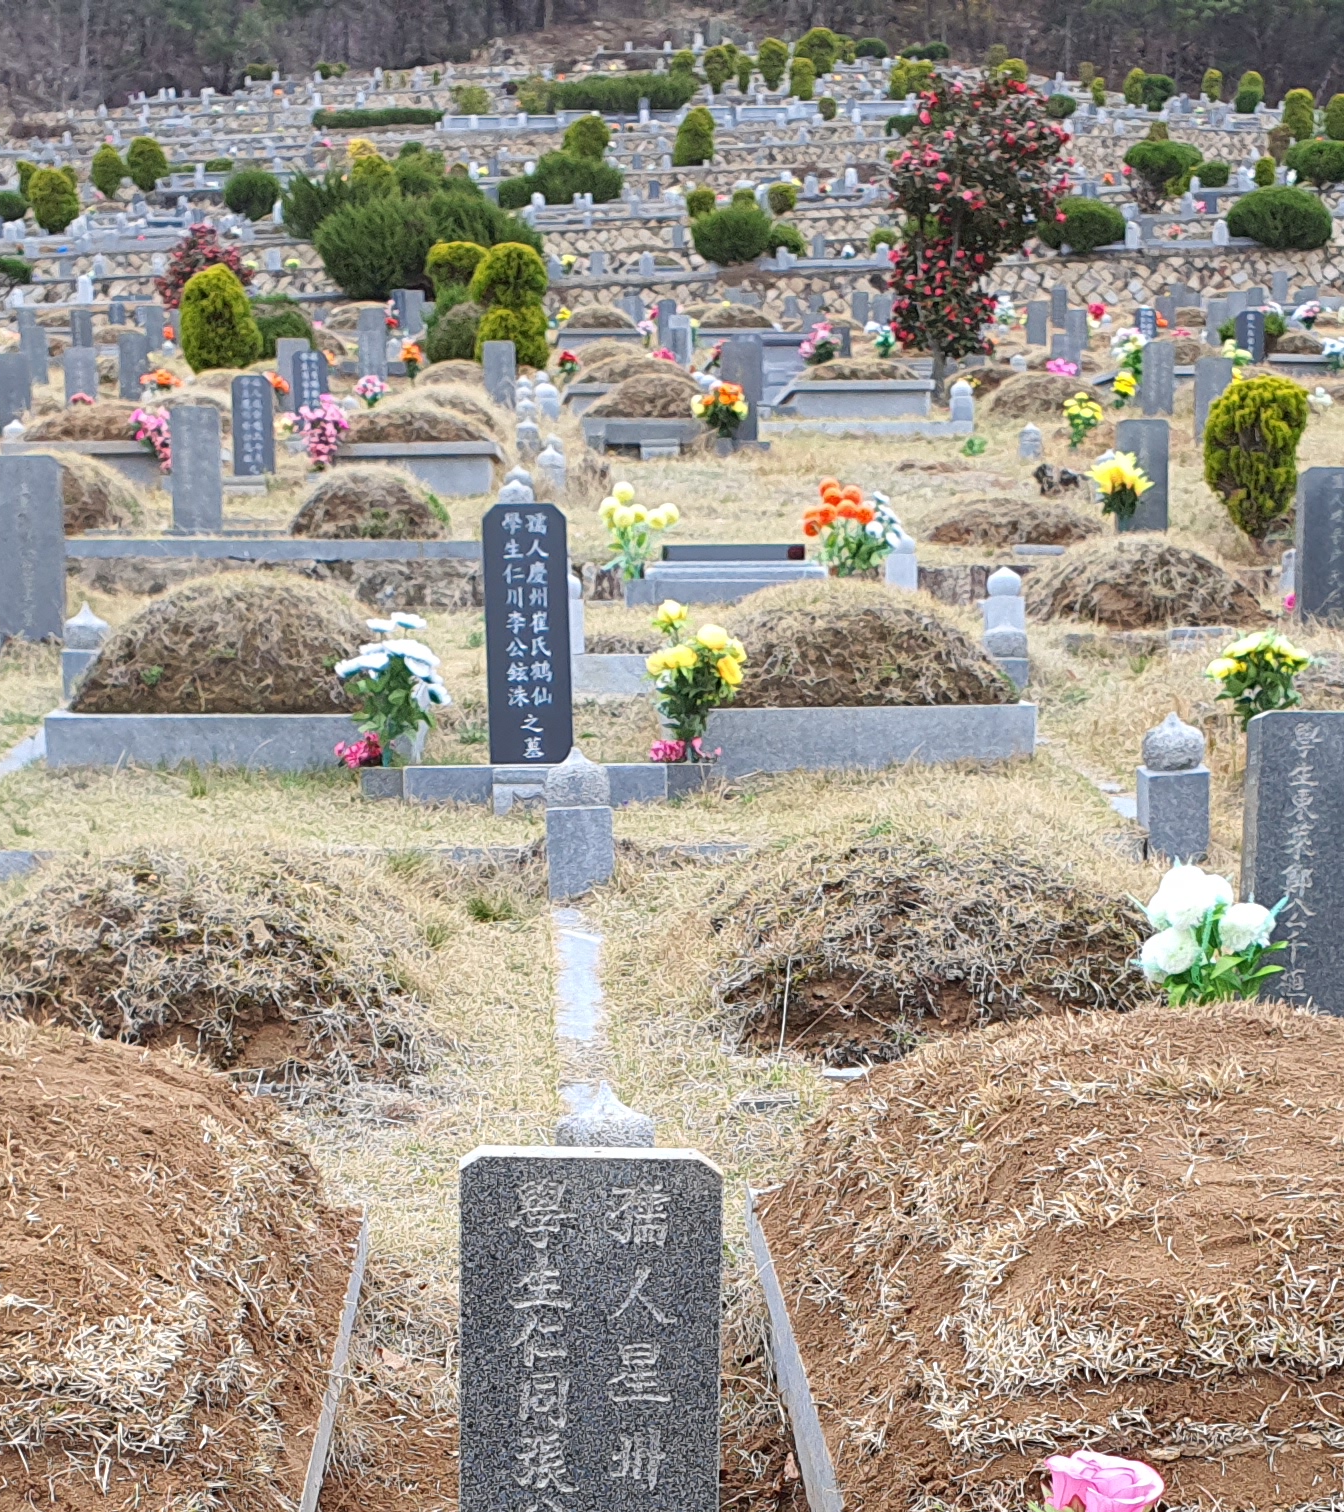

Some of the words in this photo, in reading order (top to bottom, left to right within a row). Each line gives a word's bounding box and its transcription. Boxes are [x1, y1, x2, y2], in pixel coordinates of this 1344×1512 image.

[502, 512, 530, 708] 學生仁川李公鉉洙
[525, 512, 552, 705] 孺人慶州崔氏鶴仙
[520, 712, 544, 759] 之墓
